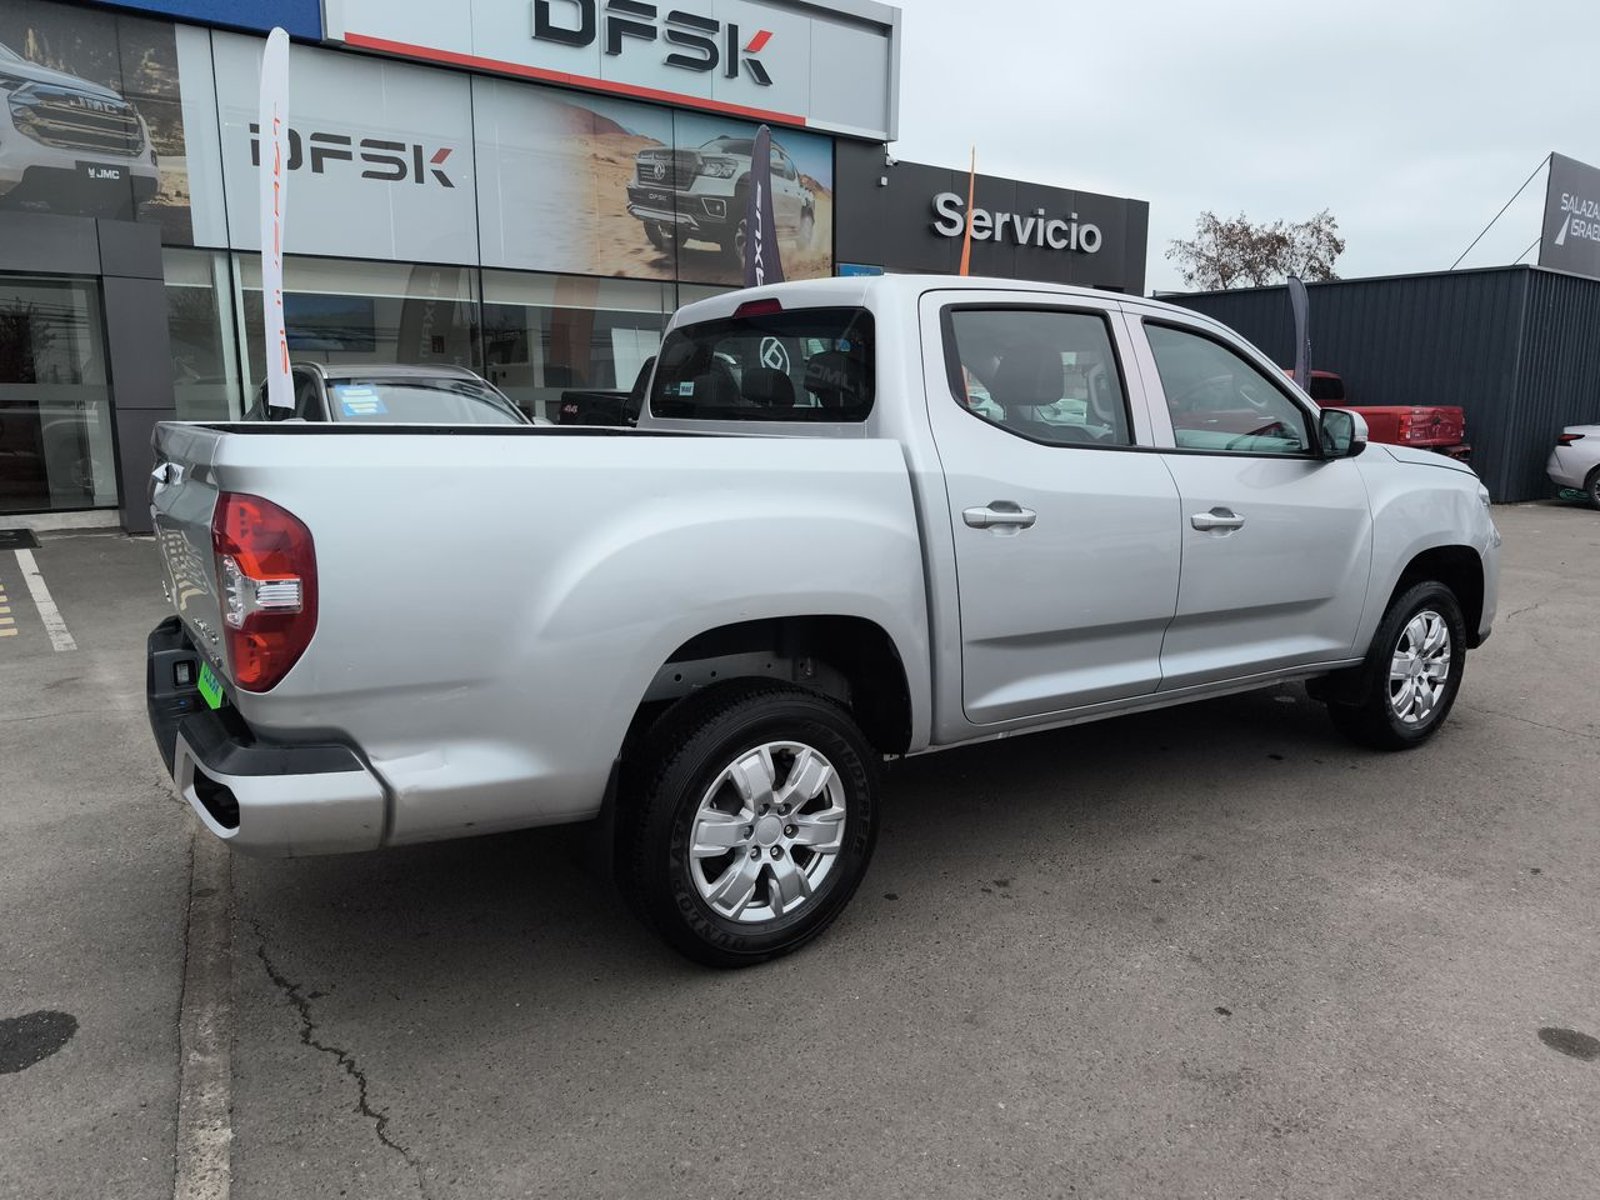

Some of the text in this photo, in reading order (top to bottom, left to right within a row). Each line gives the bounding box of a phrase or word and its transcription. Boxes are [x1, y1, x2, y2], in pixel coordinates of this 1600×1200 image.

[532, 0, 774, 86] DFSK
[96, 168, 120, 180] JMC
[932, 192, 1103, 254] Servicio
